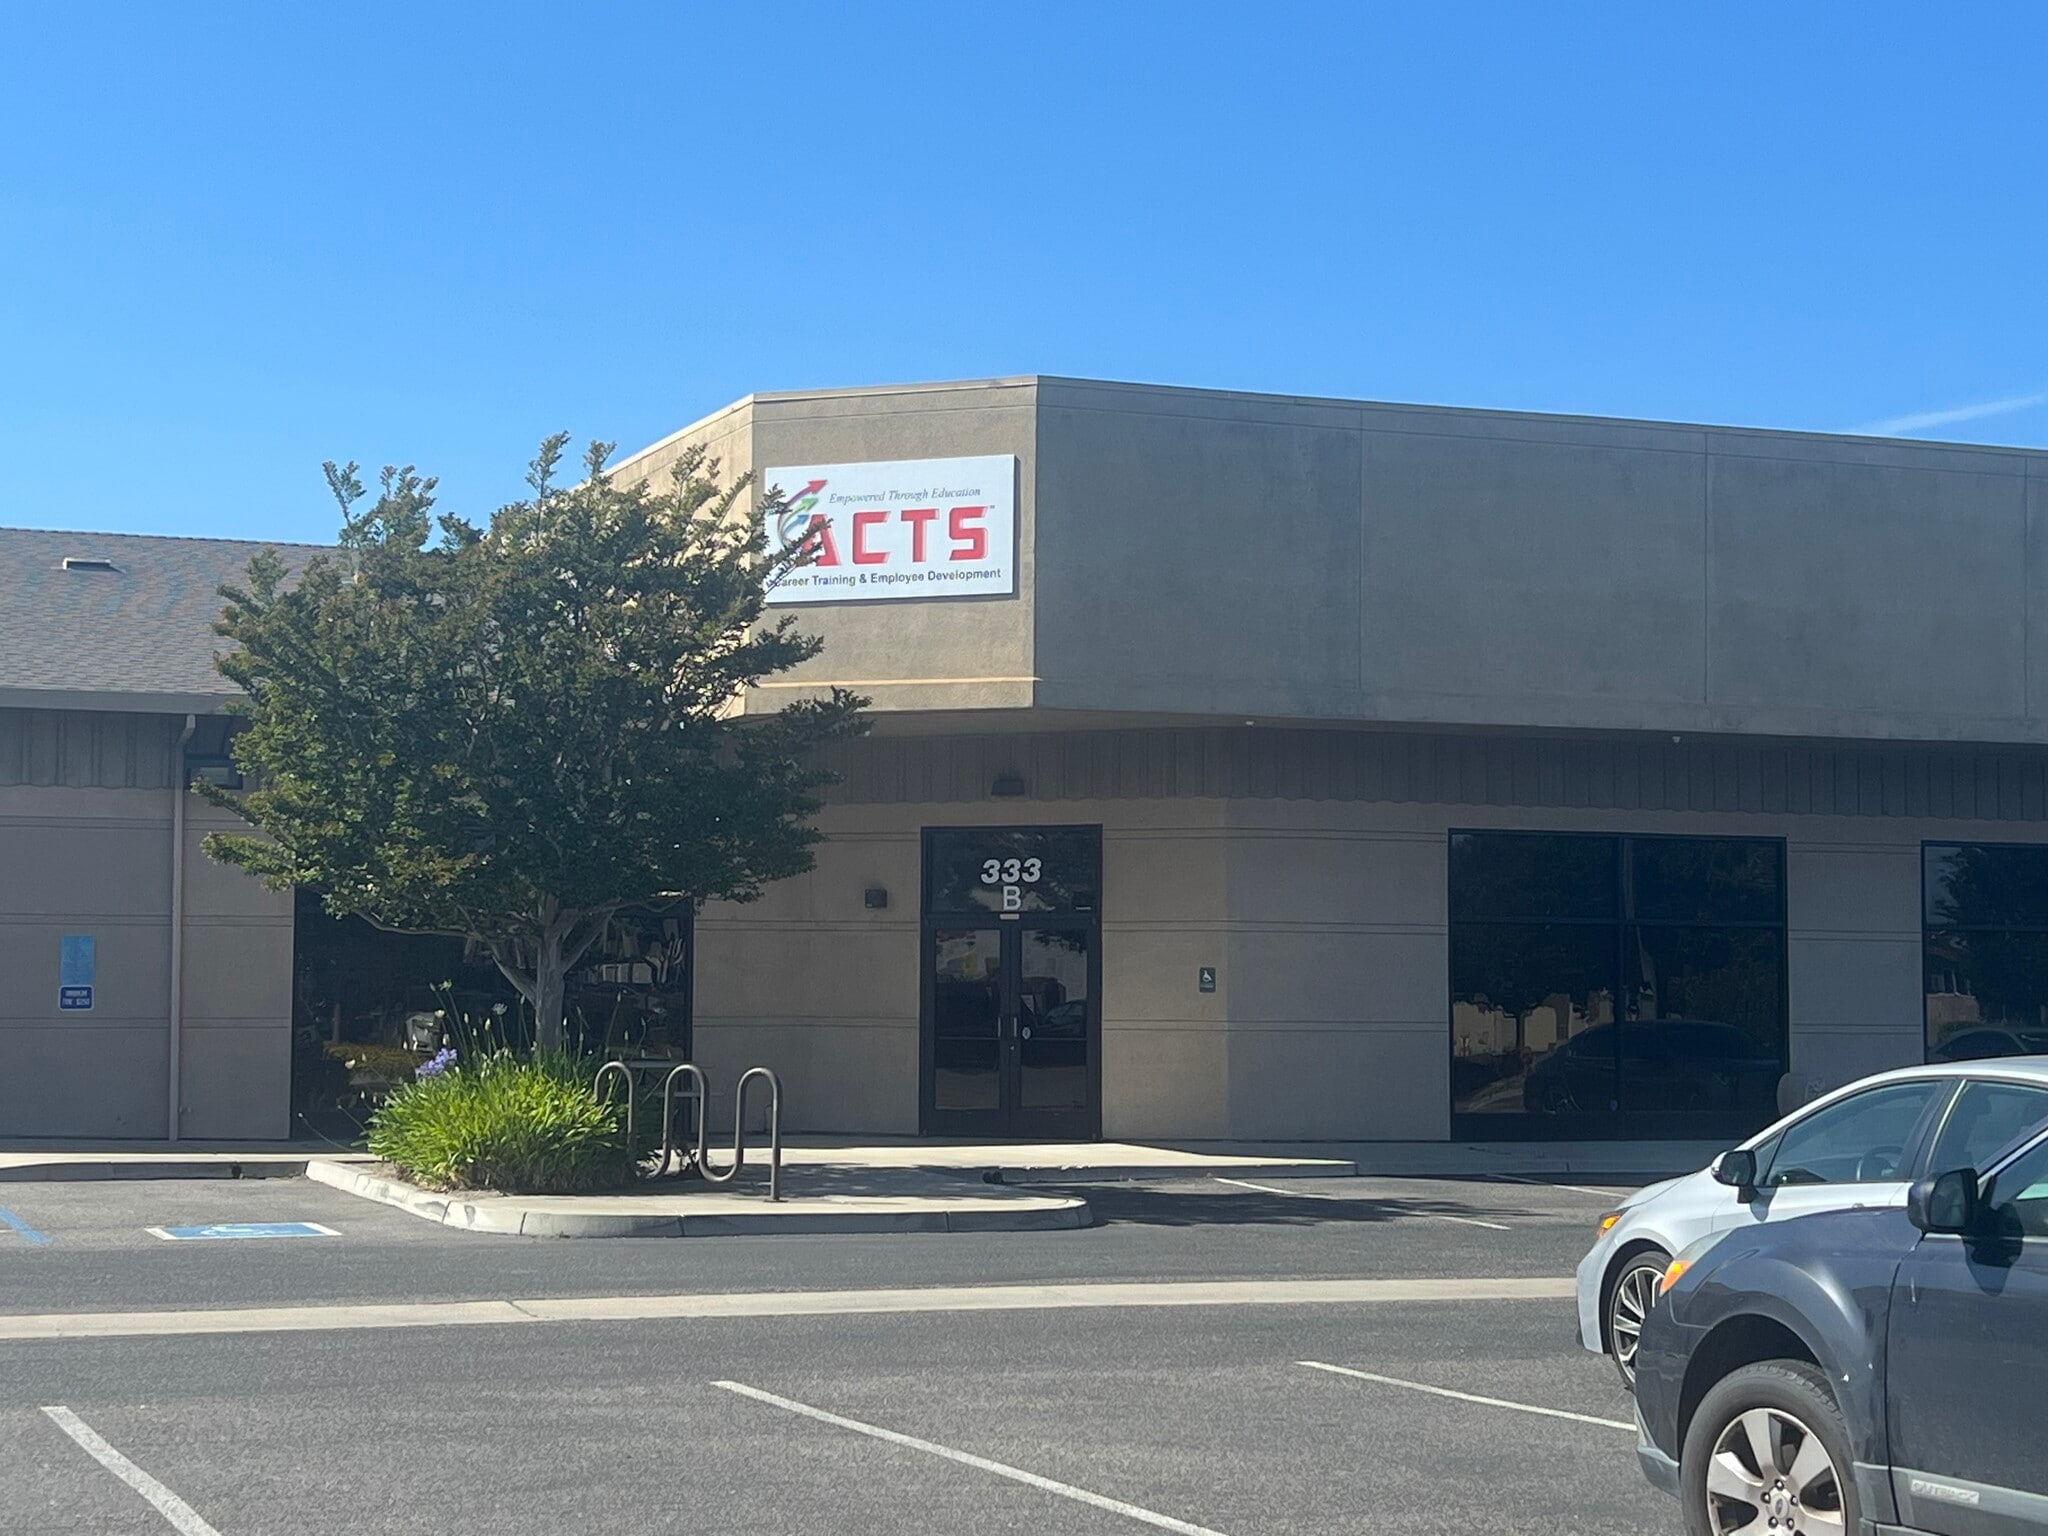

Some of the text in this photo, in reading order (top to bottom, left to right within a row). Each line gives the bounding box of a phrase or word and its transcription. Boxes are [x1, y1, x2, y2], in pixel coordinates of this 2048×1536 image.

[829, 487, 981, 506] Empowered Through Education
[797, 505, 989, 567] ACTS
[812, 574, 856, 587] Training
[860, 573, 867, 584] &
[870, 571, 925, 585] Employee
[927, 568, 1001, 582] Development
[981, 858, 1042, 884] 333
[1003, 886, 1021, 910] B
